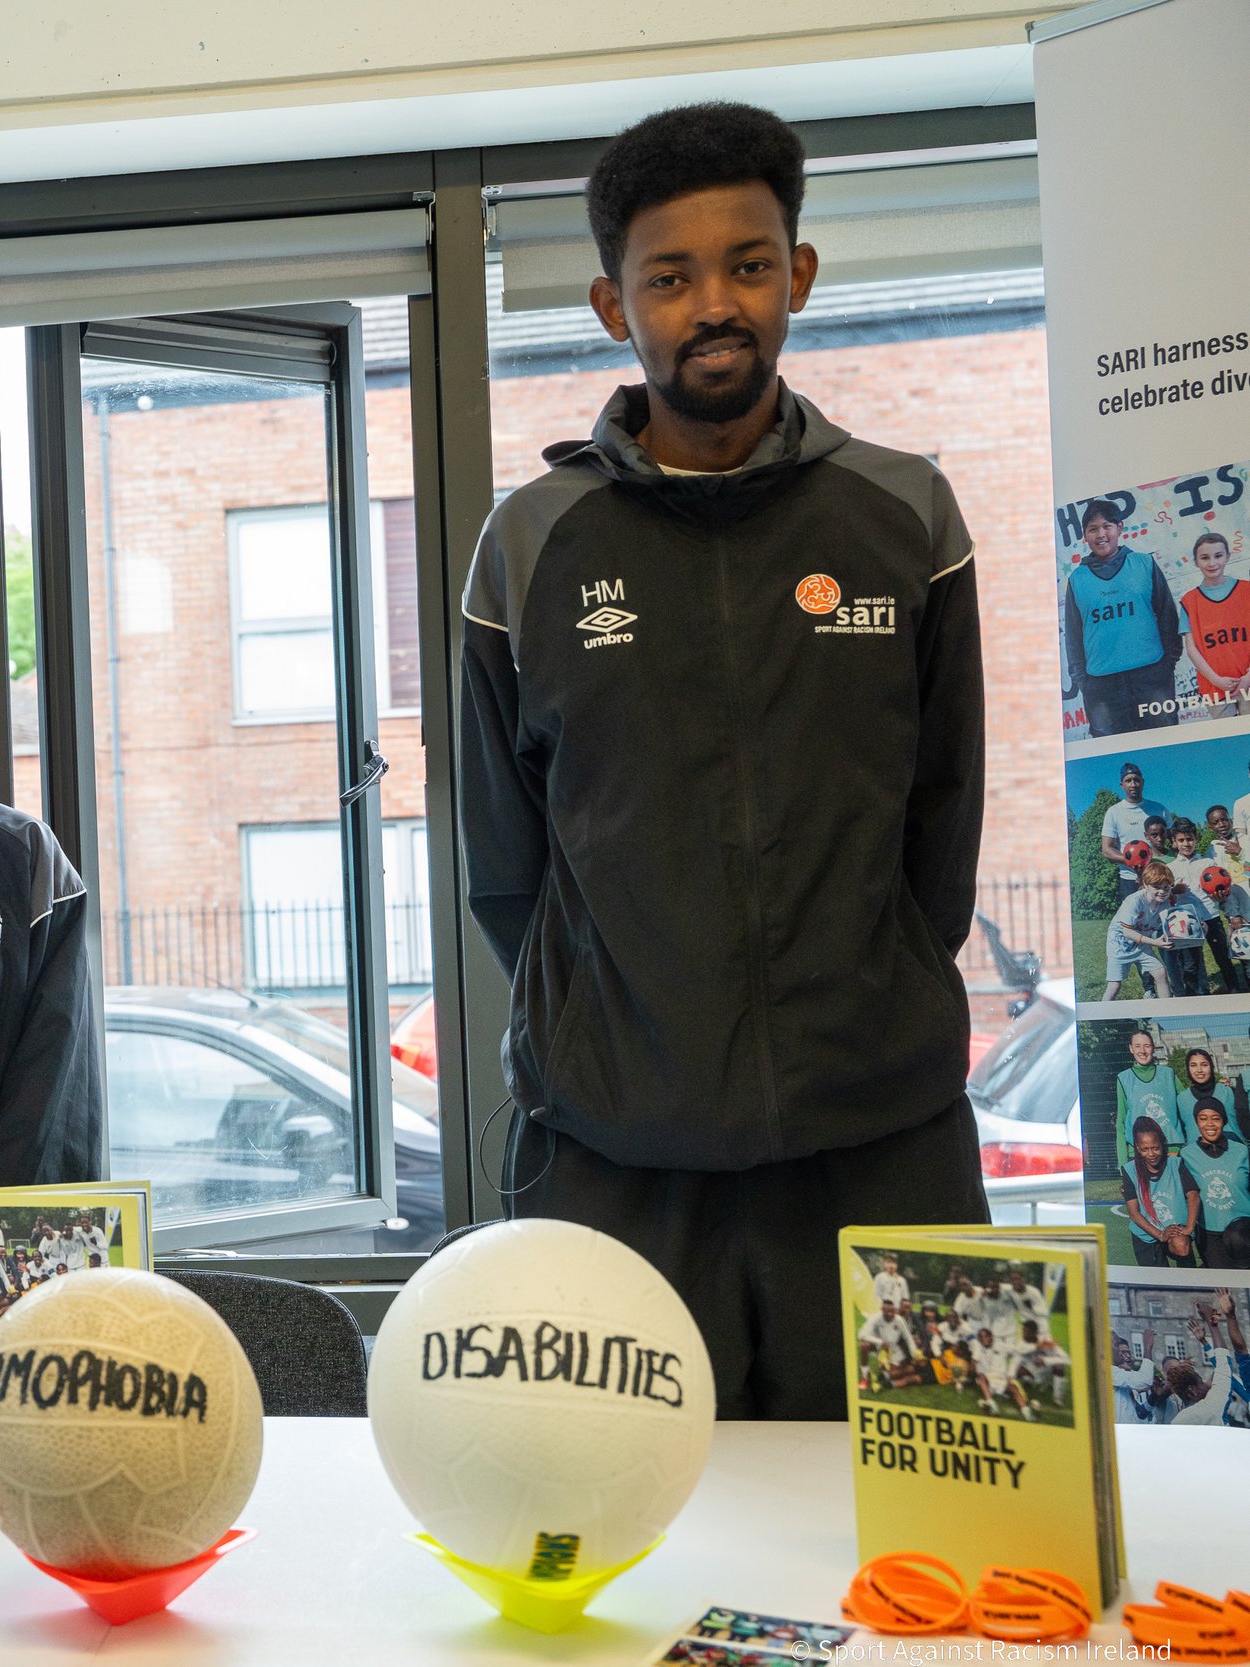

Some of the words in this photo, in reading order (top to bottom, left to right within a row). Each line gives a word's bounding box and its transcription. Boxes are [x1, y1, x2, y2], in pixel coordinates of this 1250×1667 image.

[1097, 346, 1146, 377] SARI
[1153, 331, 1249, 367] harness
[1098, 378, 1204, 416] celebrate
[1211, 368, 1250, 397] div
[581, 578, 625, 608] HM
[836, 605, 895, 626] sari
[1091, 600, 1135, 624] sari
[583, 632, 634, 650] umbro
[1204, 626, 1247, 649] sari
[1137, 690, 1238, 718] FOOTBALL
[422, 1320, 684, 1408] DISABILITIES
[859, 1405, 1016, 1456] FOOTBALL
[860, 1437, 919, 1475] FOR
[929, 1448, 1026, 1490] UNITY
